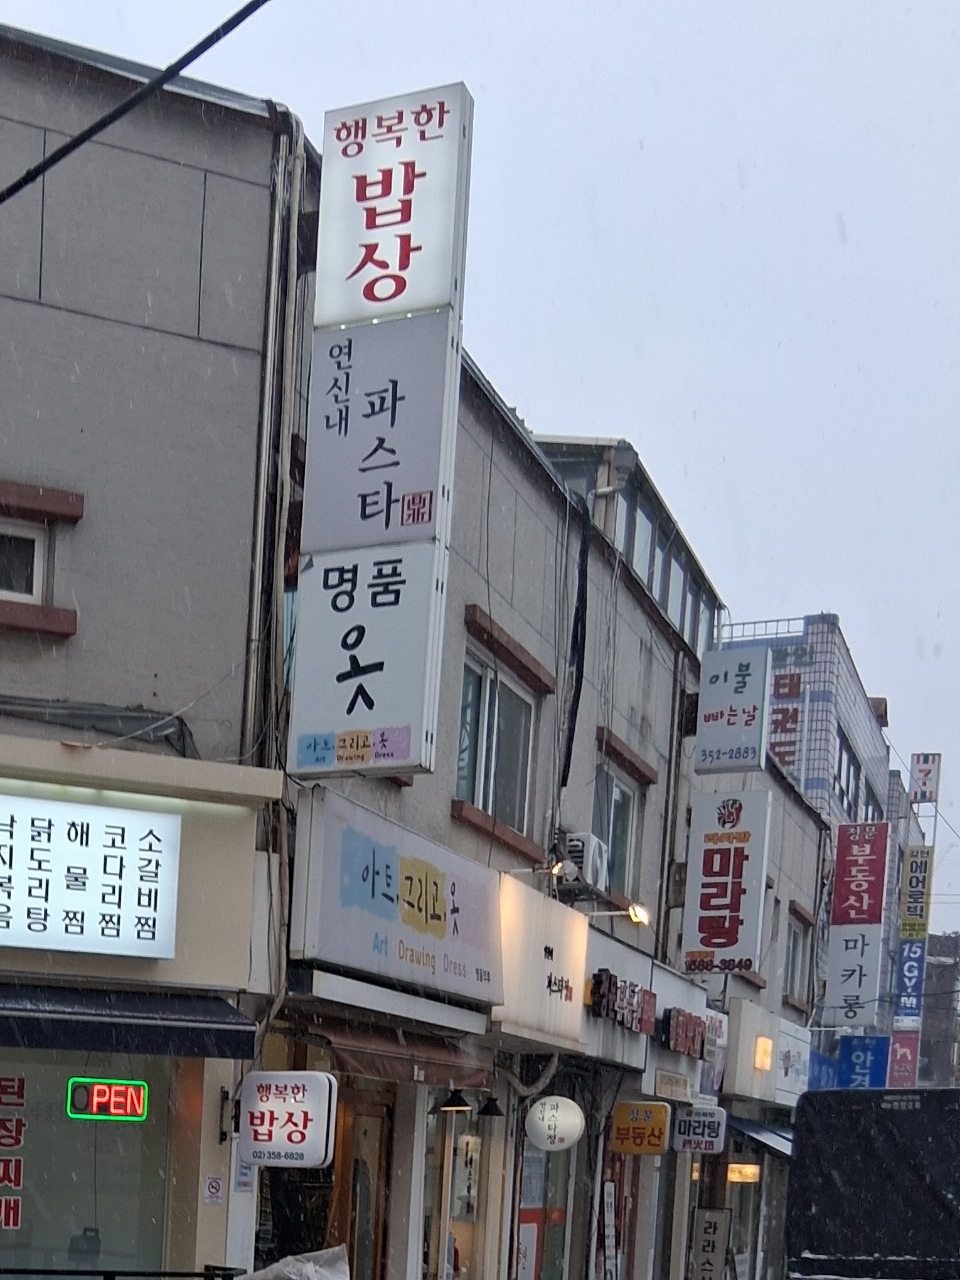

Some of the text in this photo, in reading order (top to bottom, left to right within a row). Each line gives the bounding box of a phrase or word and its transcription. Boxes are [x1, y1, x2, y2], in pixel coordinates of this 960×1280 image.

[334, 100, 450, 158] 행복한
[346, 159, 427, 303] 밥상
[324, 337, 353, 438] 연신내
[357, 378, 406, 531] 파스타
[322, 558, 406, 613] 명품
[335, 624, 385, 716] 옷
[708, 661, 752, 694] 이불
[25, 816, 55, 933] 닭도리탕
[61, 821, 91, 936] 해물찜
[98, 824, 128, 939] 코다리찜
[133, 829, 163, 942] 소갈비찜
[698, 847, 750, 949] 마라탕
[840, 843, 877, 919] 부동산
[906, 860, 928, 919] 에어로빅
[372, 932, 467, 978] Art Drawing Dress
[839, 933, 870, 1020] 마카롱
[72, 1083, 145, 1116] OPEN
[247, 1109, 314, 1144] 밥상
[256, 1083, 308, 1104] 행복한
[678, 1119, 721, 1139] 마라탕
[615, 1126, 663, 1147] 부동산
